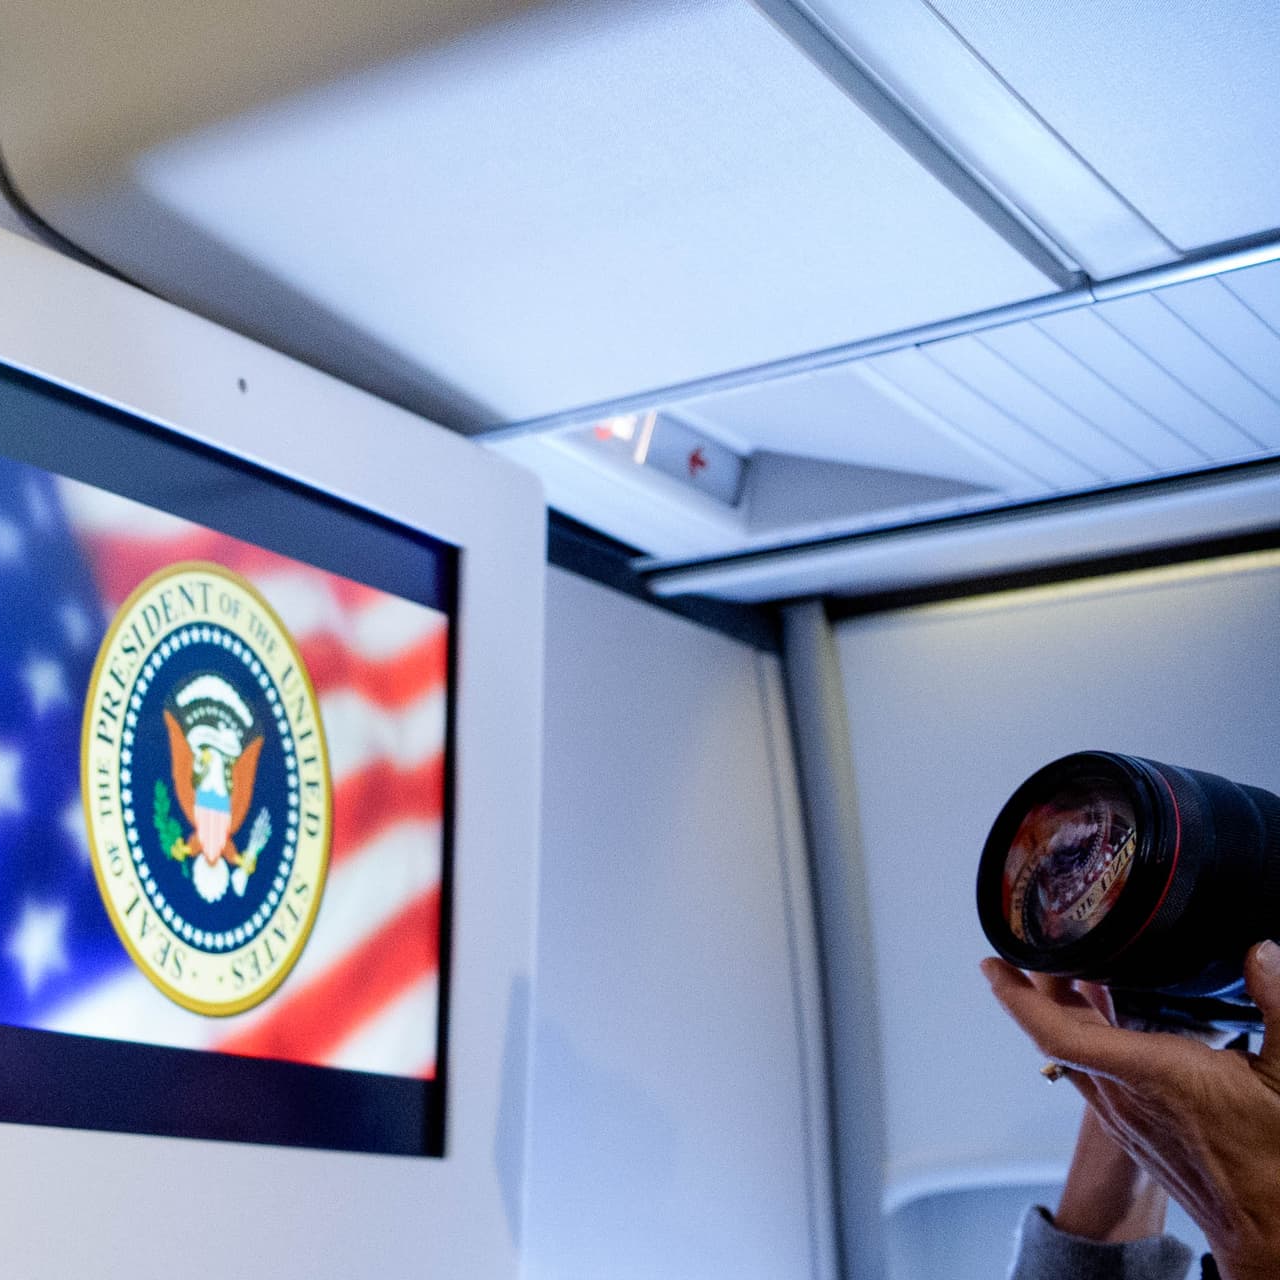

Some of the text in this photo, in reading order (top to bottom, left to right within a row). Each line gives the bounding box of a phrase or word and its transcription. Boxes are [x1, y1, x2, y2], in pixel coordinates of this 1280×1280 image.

[96, 582, 320, 989] SEAL OF THE PRESIDENT OF THE UNITED STATES
